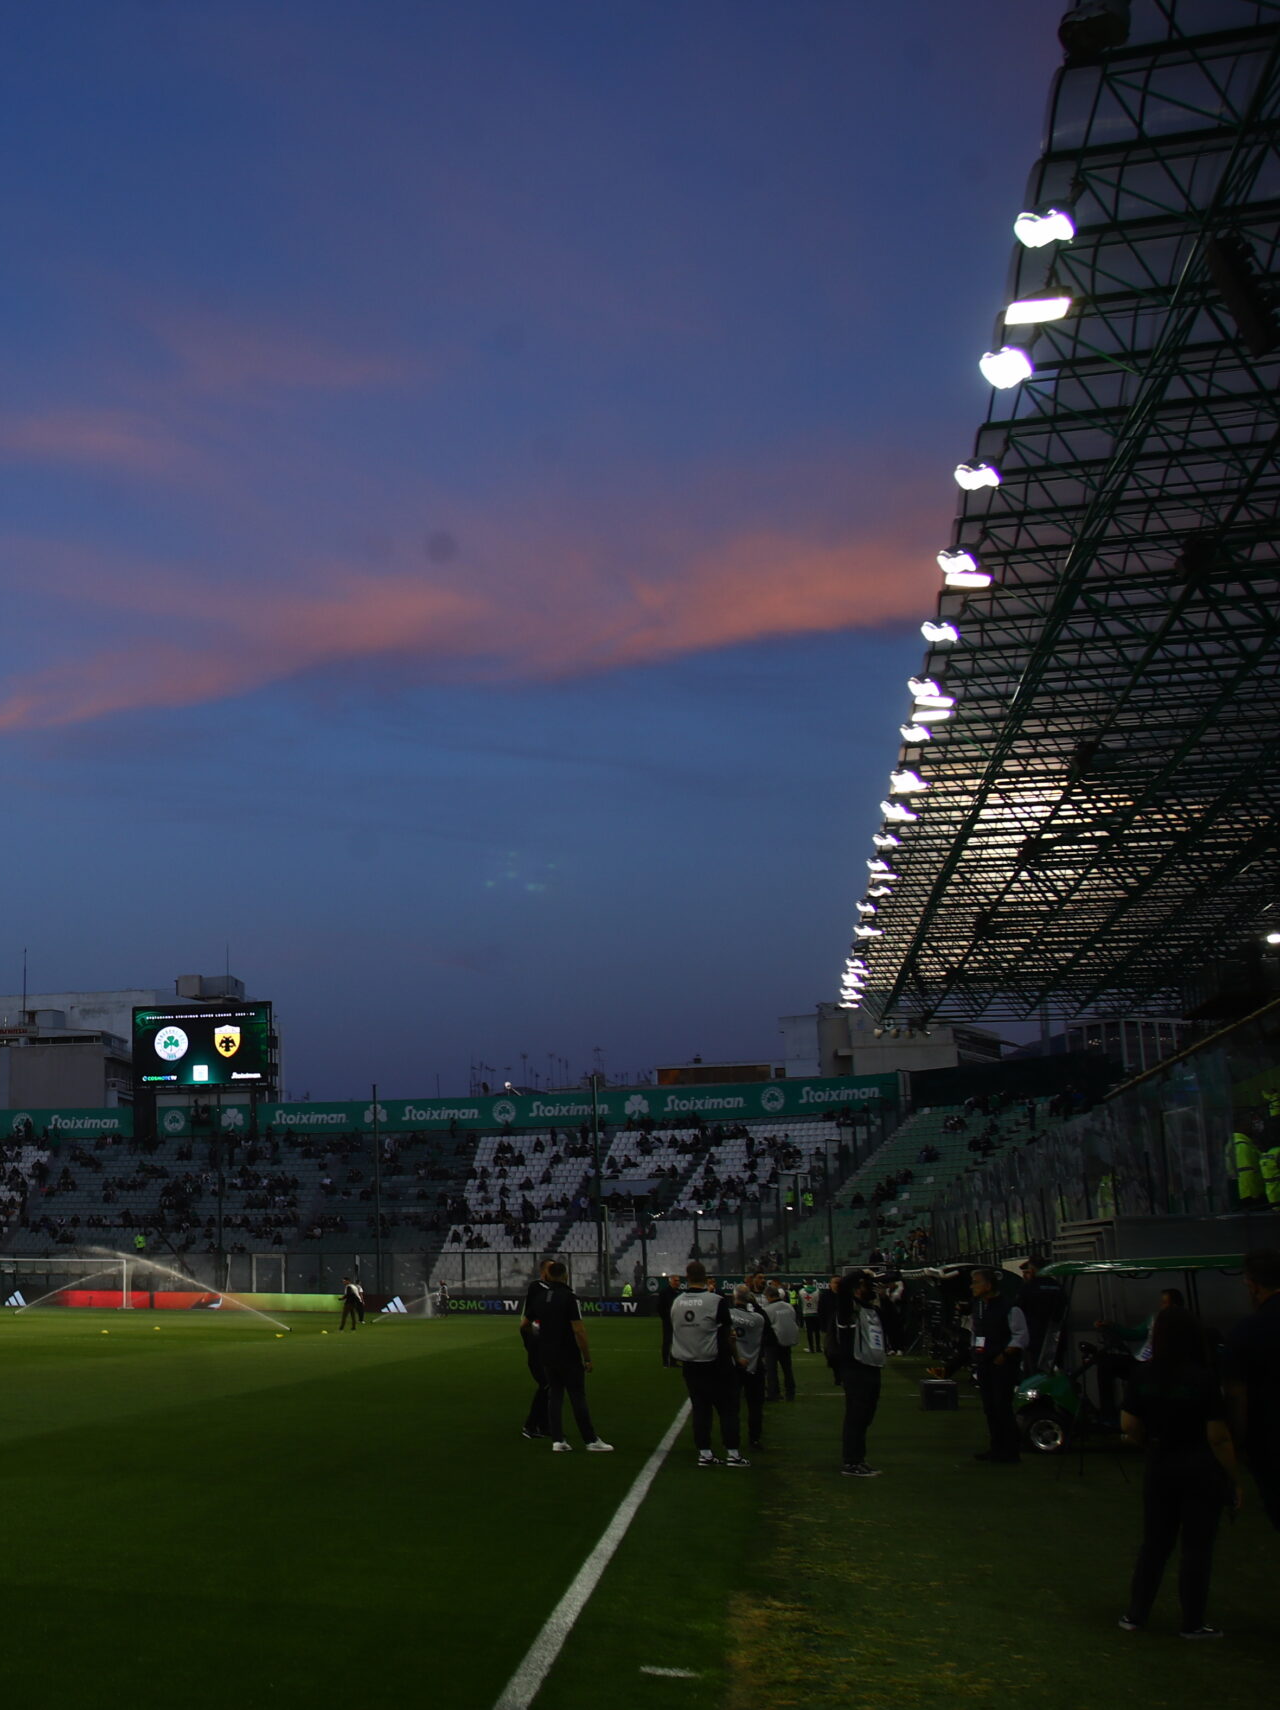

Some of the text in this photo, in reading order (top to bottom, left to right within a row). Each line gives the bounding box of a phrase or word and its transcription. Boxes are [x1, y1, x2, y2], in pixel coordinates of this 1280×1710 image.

[798, 1086, 880, 1104] Stoiximan
[663, 1095, 744, 1112] Stoiximan
[272, 1109, 346, 1125] Stoiximan
[401, 1105, 480, 1121] Stoiximan
[48, 1114, 119, 1130] Stoiximan
[448, 1300, 519, 1311] OSMOTE TV
[621, 1301, 638, 1313] TV
